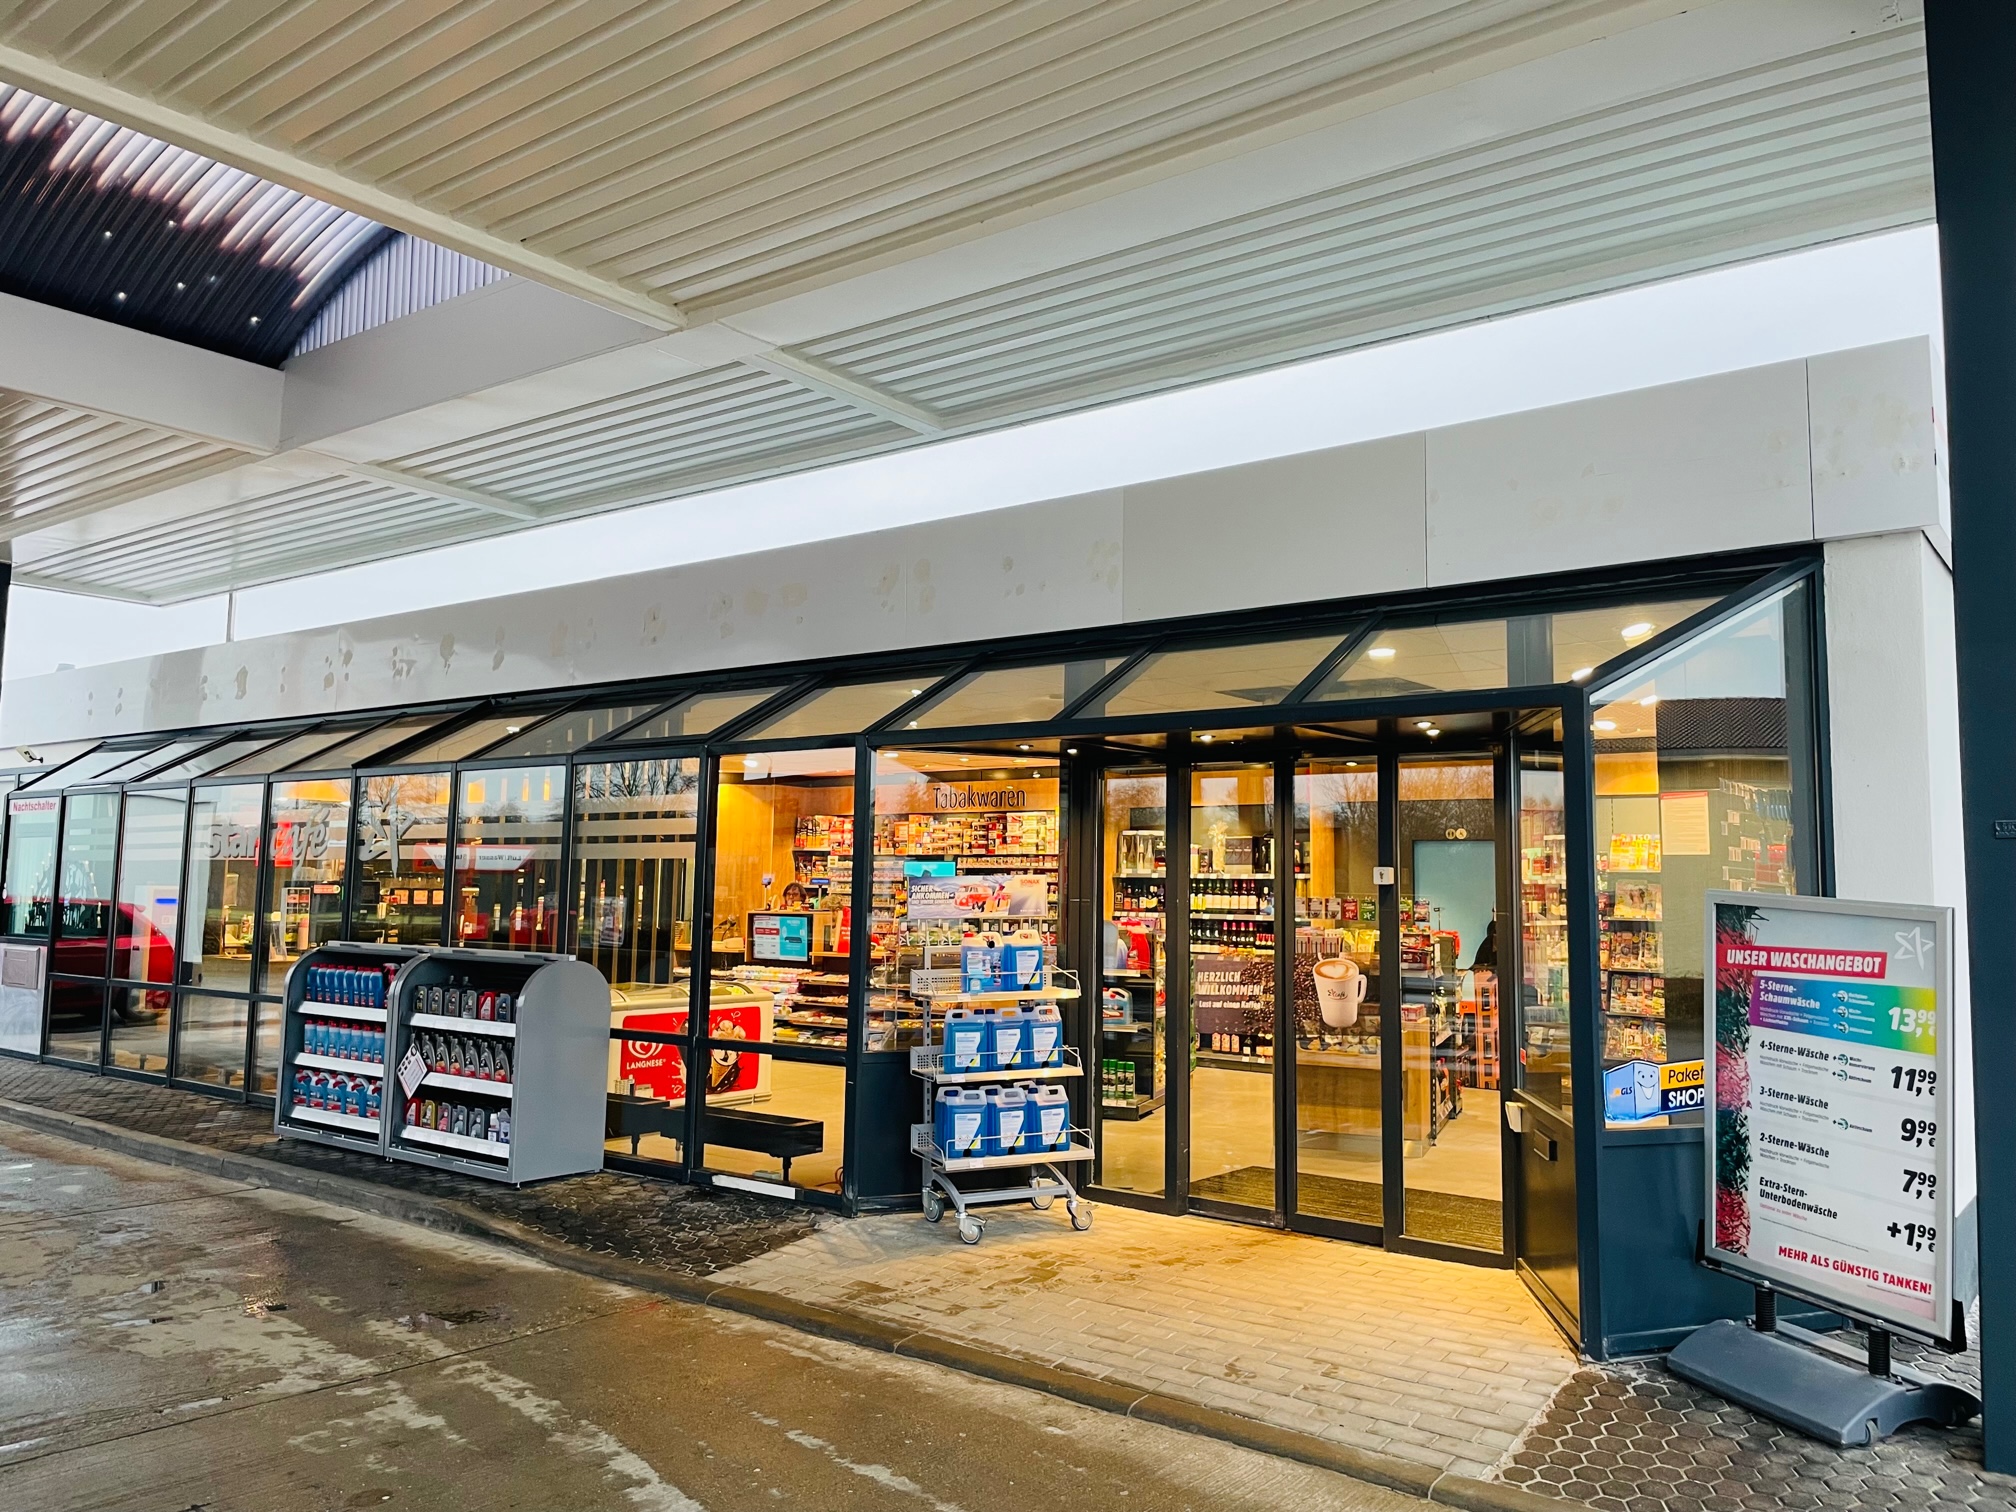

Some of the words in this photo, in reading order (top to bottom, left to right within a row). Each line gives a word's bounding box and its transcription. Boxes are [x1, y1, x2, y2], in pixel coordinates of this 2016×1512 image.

[933, 784, 1027, 809] Tabakwaren
[13, 800, 57, 812] Nachtschalter
[204, 822, 259, 859] star
[911, 884, 934, 892] SICHER
[911, 892, 950, 900] ANKOMMEN
[1727, 949, 1768, 966] UNSER
[1770, 951, 1882, 973] WASCHANGEBOT
[1197, 971, 1241, 982] HERZLICH
[1198, 984, 1264, 996] WILLKOMMEN!
[1760, 980, 1797, 993] 5-Sterne-
[1212, 1000, 1223, 1008] auf
[1760, 991, 1820, 1009] Schaumwäsche
[1760, 1040, 1830, 1062] 4-Sterne-Wäsche
[627, 1059, 663, 1070] LANGNESE
[1668, 1066, 1704, 1084] Paket
[1621, 1086, 1632, 1096] GLS
[1668, 1087, 1704, 1108] SHOP
[1760, 1086, 1829, 1110] 3-Sterne-Wäsche
[1760, 1132, 1830, 1158] 2-Sterne-Wäsche
[1760, 1176, 1808, 1198] Extra-Stern-
[1760, 1188, 1838, 1220] Unterbodenwäsche
[1778, 1245, 1808, 1263] MEHR
[1810, 1254, 1830, 1268] ALS
[1832, 1260, 1880, 1281] GÜNSTIG
[1882, 1272, 1932, 1296] TANKEN!
